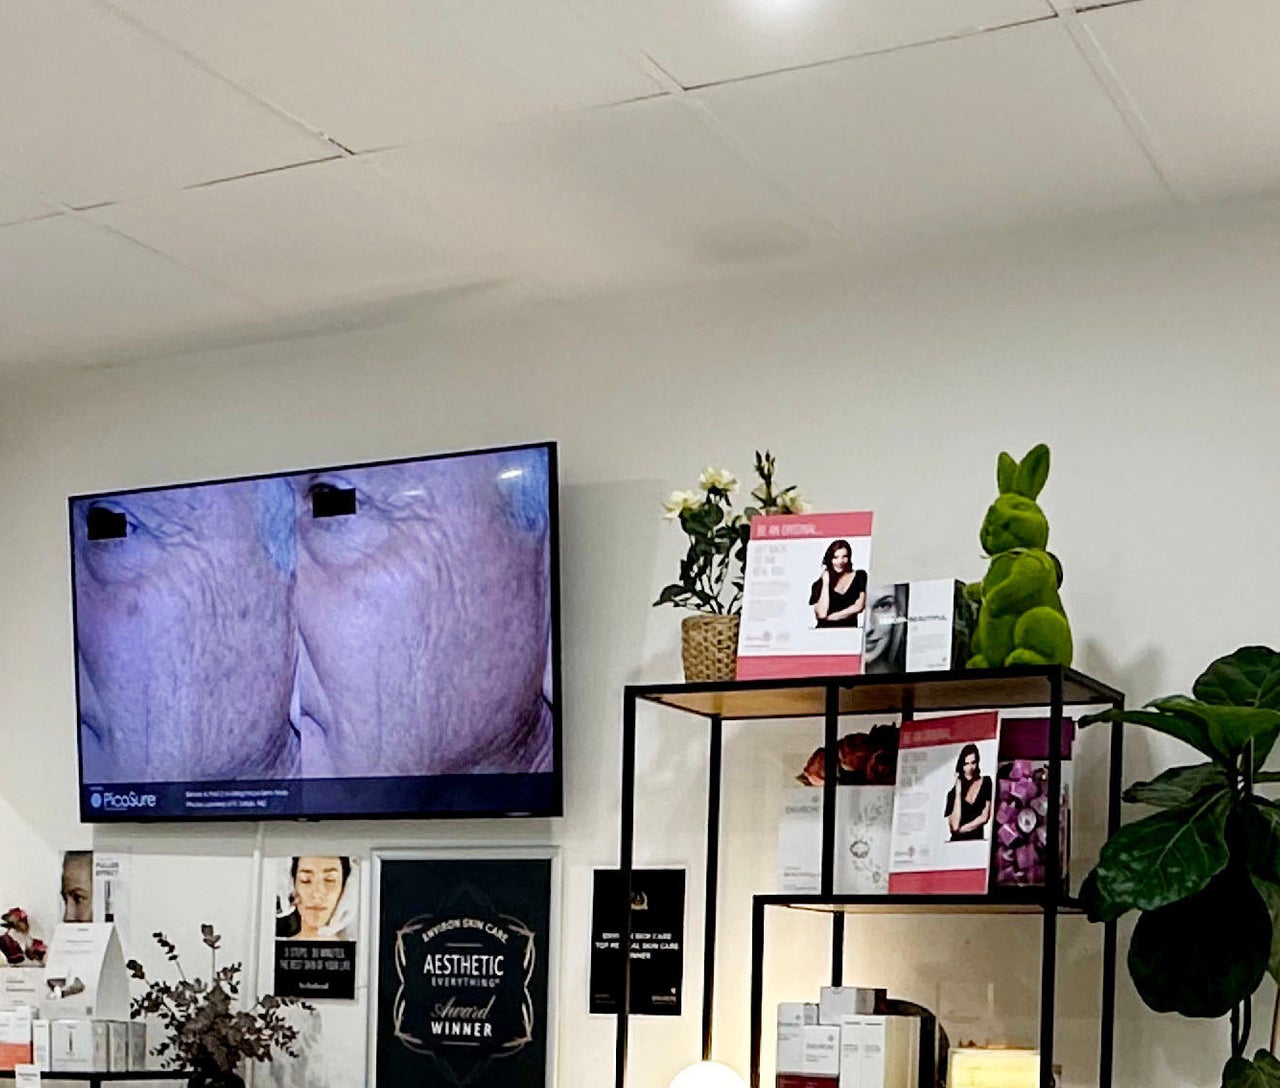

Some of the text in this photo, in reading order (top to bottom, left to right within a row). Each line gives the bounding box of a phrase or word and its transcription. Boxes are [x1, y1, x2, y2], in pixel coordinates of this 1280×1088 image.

[104, 790, 157, 808] PicoSure
[485, 922, 508, 943] CARE
[423, 954, 504, 976] AESTHETIC
[430, 995, 496, 1020] Award
[430, 1021, 492, 1037] WINNER
